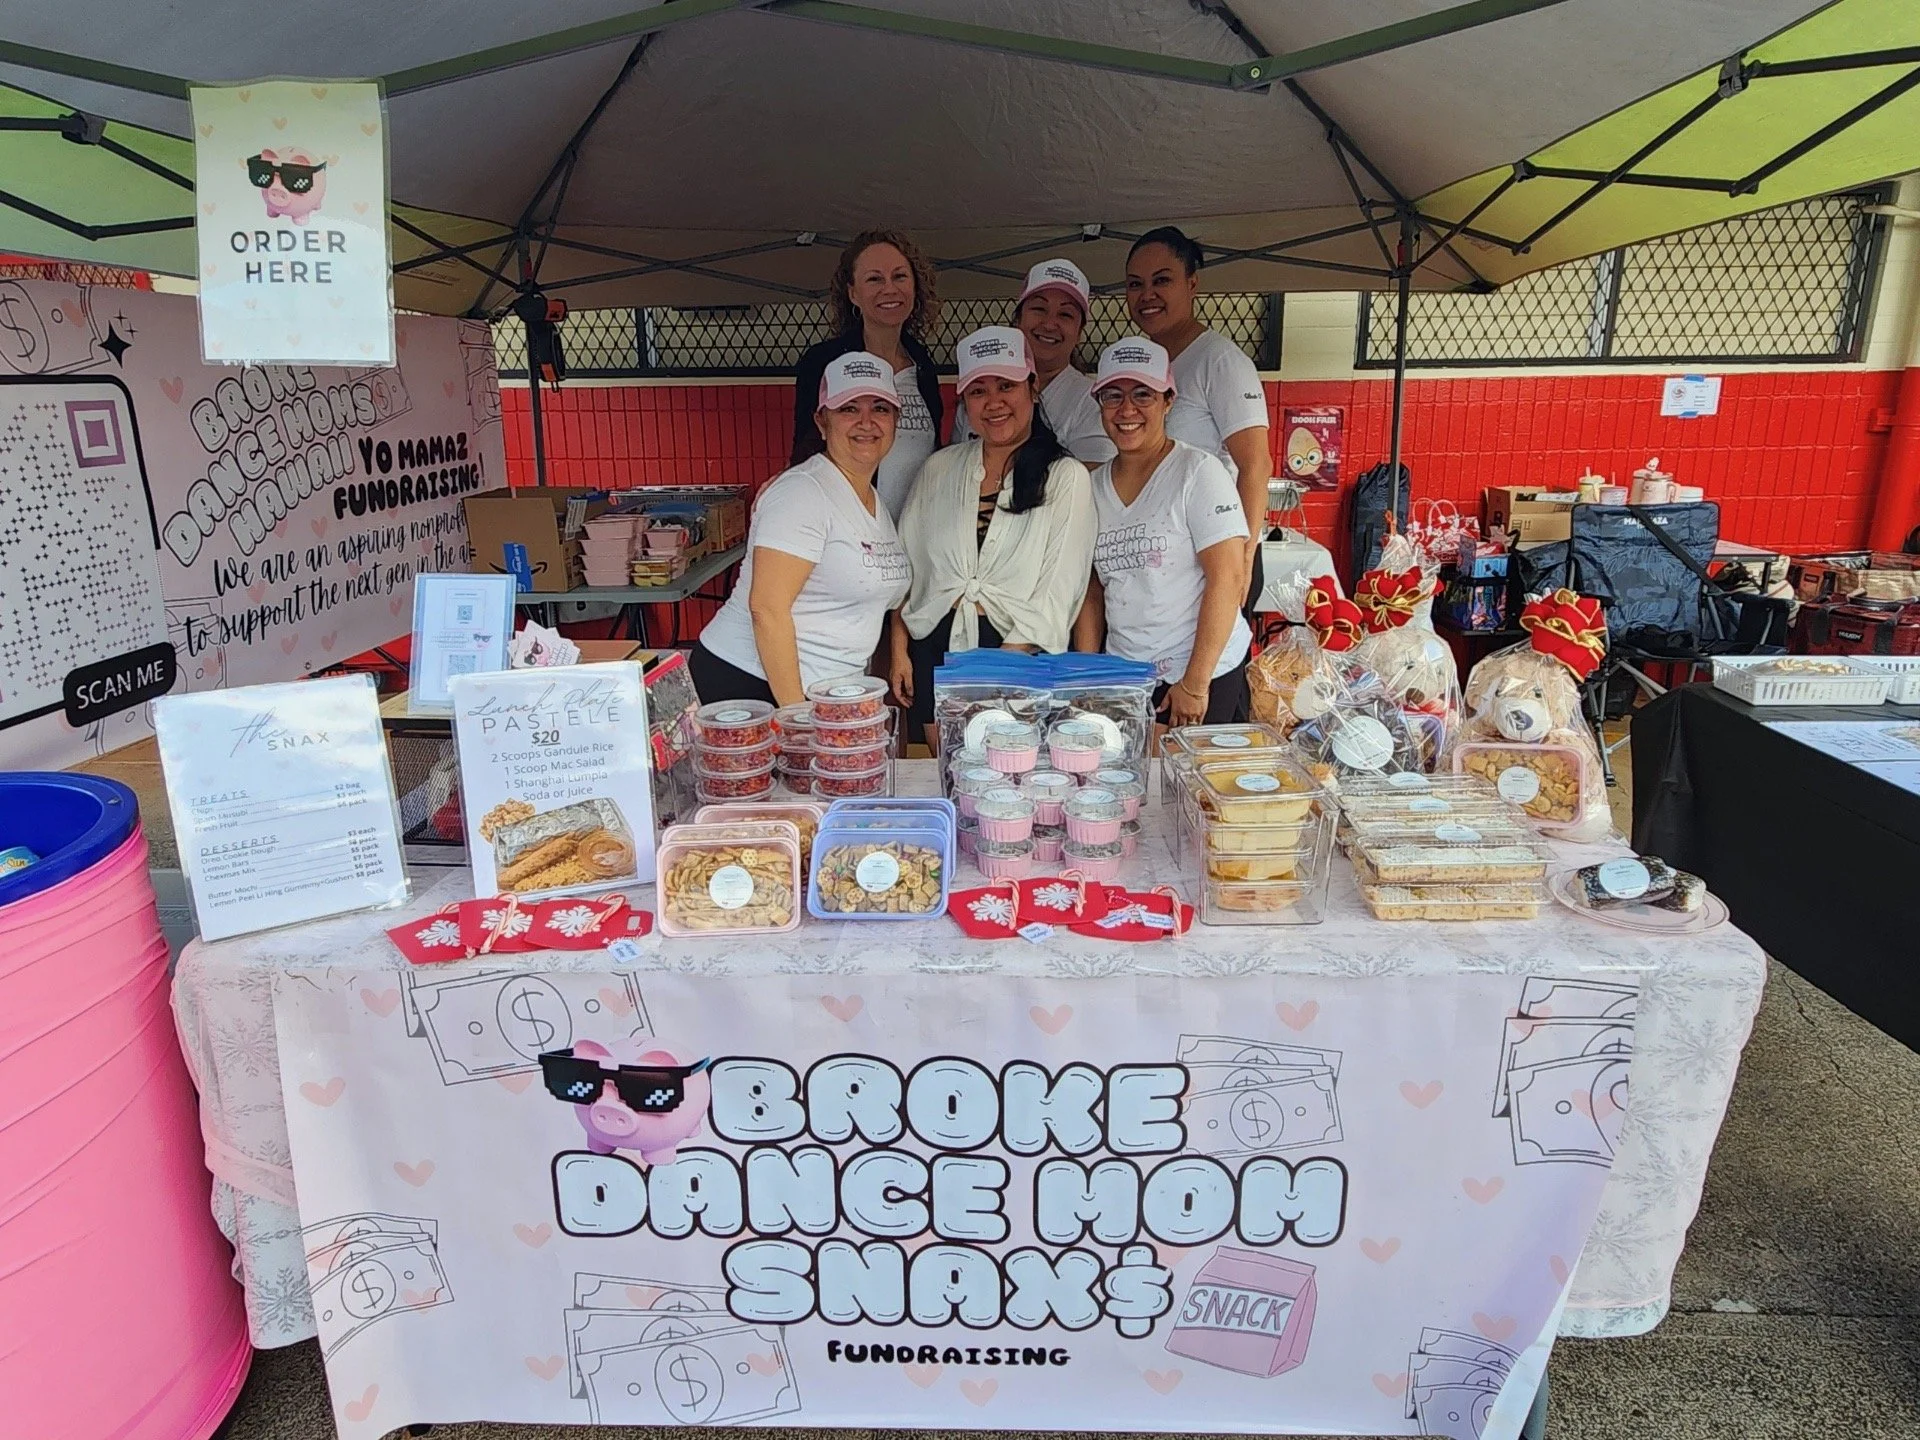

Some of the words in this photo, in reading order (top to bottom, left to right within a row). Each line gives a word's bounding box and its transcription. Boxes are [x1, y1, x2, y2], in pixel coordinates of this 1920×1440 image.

[230, 229, 347, 254] ORDER
[245, 261, 333, 284] HERE
[358, 436, 393, 475] YO
[398, 432, 468, 470] MAMAZ
[162, 414, 286, 567] DANCE
[280, 383, 377, 449] MOMS
[333, 452, 486, 520] FUNDRAISING!
[228, 431, 355, 556] HAWAII
[213, 557, 254, 597] We
[261, 550, 300, 585] are
[305, 544, 333, 573] an
[337, 523, 406, 566] aspiring
[410, 500, 467, 542] nonprofi
[185, 616, 212, 657] to
[218, 585, 307, 646] support
[307, 577, 341, 616] the
[346, 562, 383, 602] next
[385, 563, 416, 595] gen
[416, 549, 432, 574] in
[434, 541, 456, 570] the
[76, 667, 132, 709] SCAN
[137, 660, 166, 690] ME
[467, 682, 556, 717] Lunch
[563, 679, 625, 717] Plate
[230, 706, 288, 758] the
[482, 706, 621, 735] PASTELE
[267, 731, 331, 751] SNAX
[531, 730, 561, 746] $20
[491, 753, 499, 763] 2
[501, 748, 541, 762] Scoops
[544, 744, 589, 758] Gandule
[592, 742, 615, 753] Rice
[514, 762, 548, 776] Scoop
[551, 760, 573, 772] Mac
[576, 756, 605, 768] Salad
[514, 774, 565, 789] Shanghai
[189, 790, 248, 807] TREATS
[522, 790, 550, 802] Soda
[553, 788, 565, 798] or
[567, 786, 593, 798] Juice
[200, 835, 279, 857] DESSERTS
[222, 850, 249, 861] Cookie
[250, 845, 276, 856] Dough
[361, 843, 380, 853] pack
[202, 863, 230, 874] Lemon
[232, 860, 250, 868] Bars
[242, 866, 257, 875] Mix
[365, 859, 384, 869] pack
[366, 867, 385, 877] pack
[208, 889, 232, 900] Butter
[234, 884, 258, 894] Mochi
[708, 1052, 1191, 1157] BROKE
[550, 1143, 1011, 1241] DANCE
[1032, 1156, 1350, 1248] MOM
[721, 1237, 1175, 1340] SNAX$
[1182, 1289, 1292, 1332] SNACK
[826, 1339, 1072, 1369] FUNDRAISING
